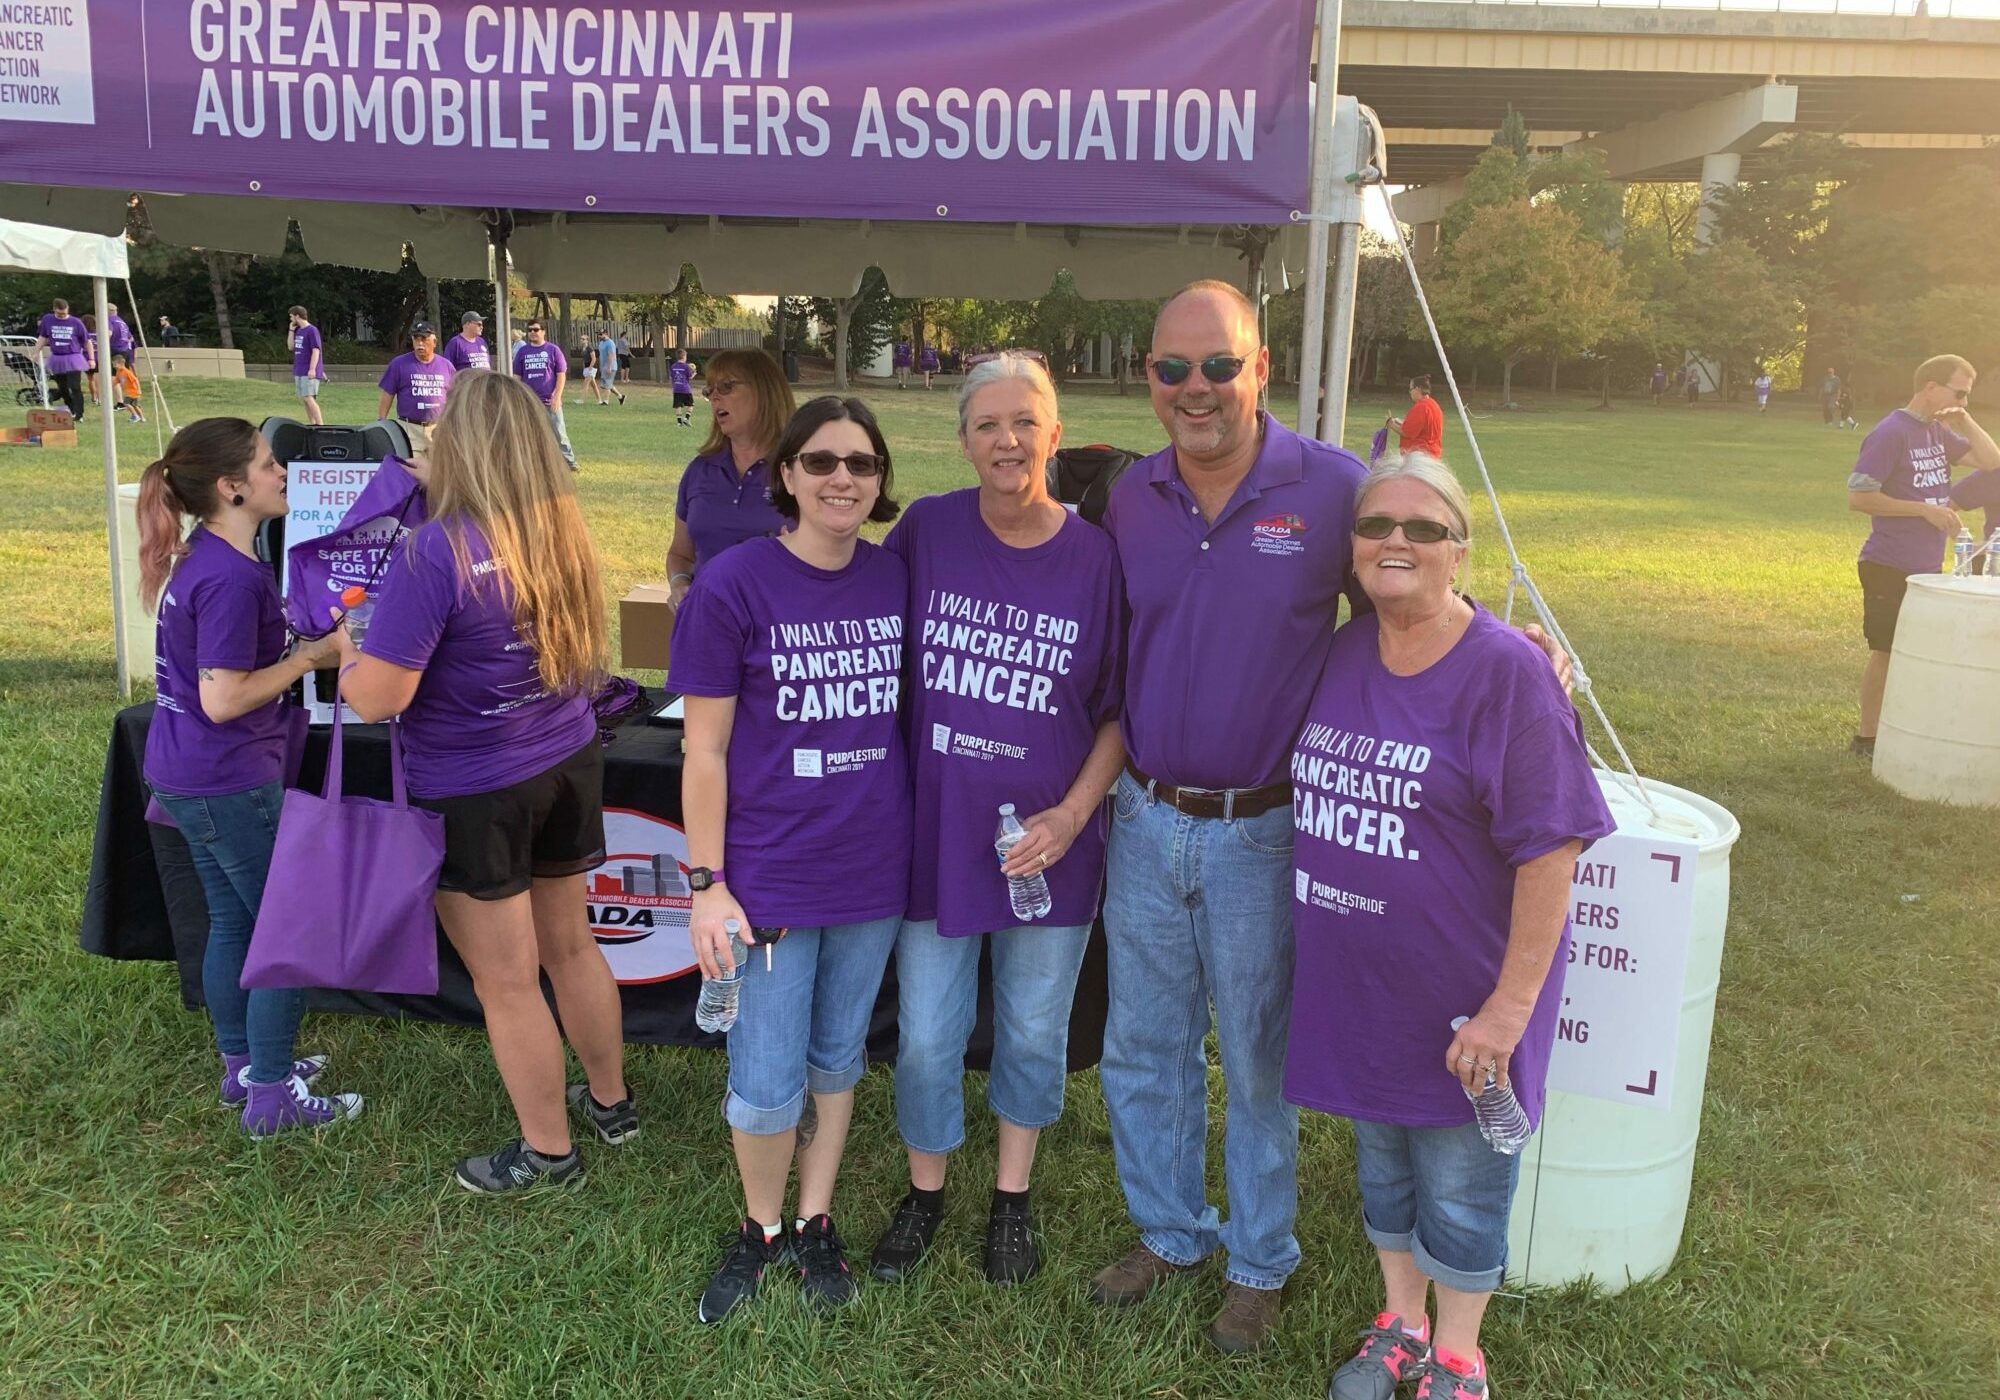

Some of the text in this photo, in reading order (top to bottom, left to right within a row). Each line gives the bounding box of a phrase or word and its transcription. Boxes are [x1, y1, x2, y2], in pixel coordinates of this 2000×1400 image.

[0, 4, 73, 27] NCREATIC
[190, 0, 793, 79] GREATER CINCINNATI
[192, 68, 1257, 162] AUTOMOBILE DEALERS ASSOCIATION
[292, 510, 320, 521] FOR
[324, 510, 334, 521] A
[318, 548, 364, 562] SAFE
[331, 562, 367, 576] FOR
[770, 615, 902, 650] I WALK TO END
[928, 589, 1079, 645] I WALK TO END
[922, 619, 1073, 676] PANCREATIC
[776, 675, 900, 723] CANCER
[922, 651, 1059, 716] CANCER.
[952, 745, 995, 762] CINCINNATI 2019
[953, 732, 1028, 760] PURPLESTRIDE
[1299, 722, 1432, 774] I WALK TO END
[827, 763, 852, 774] CINCINNATI
[851, 762, 864, 772] 2019
[1291, 751, 1422, 810] PANCREATIC
[1293, 786, 1420, 861] CANCER.
[629, 896, 658, 905] DEALERS
[1311, 895, 1350, 916] CINCINNATI 2019
[1312, 880, 1387, 915] PURPLESTRIDE
[1571, 901, 1620, 930] ERS
[1584, 942, 1638, 974] FOR:
